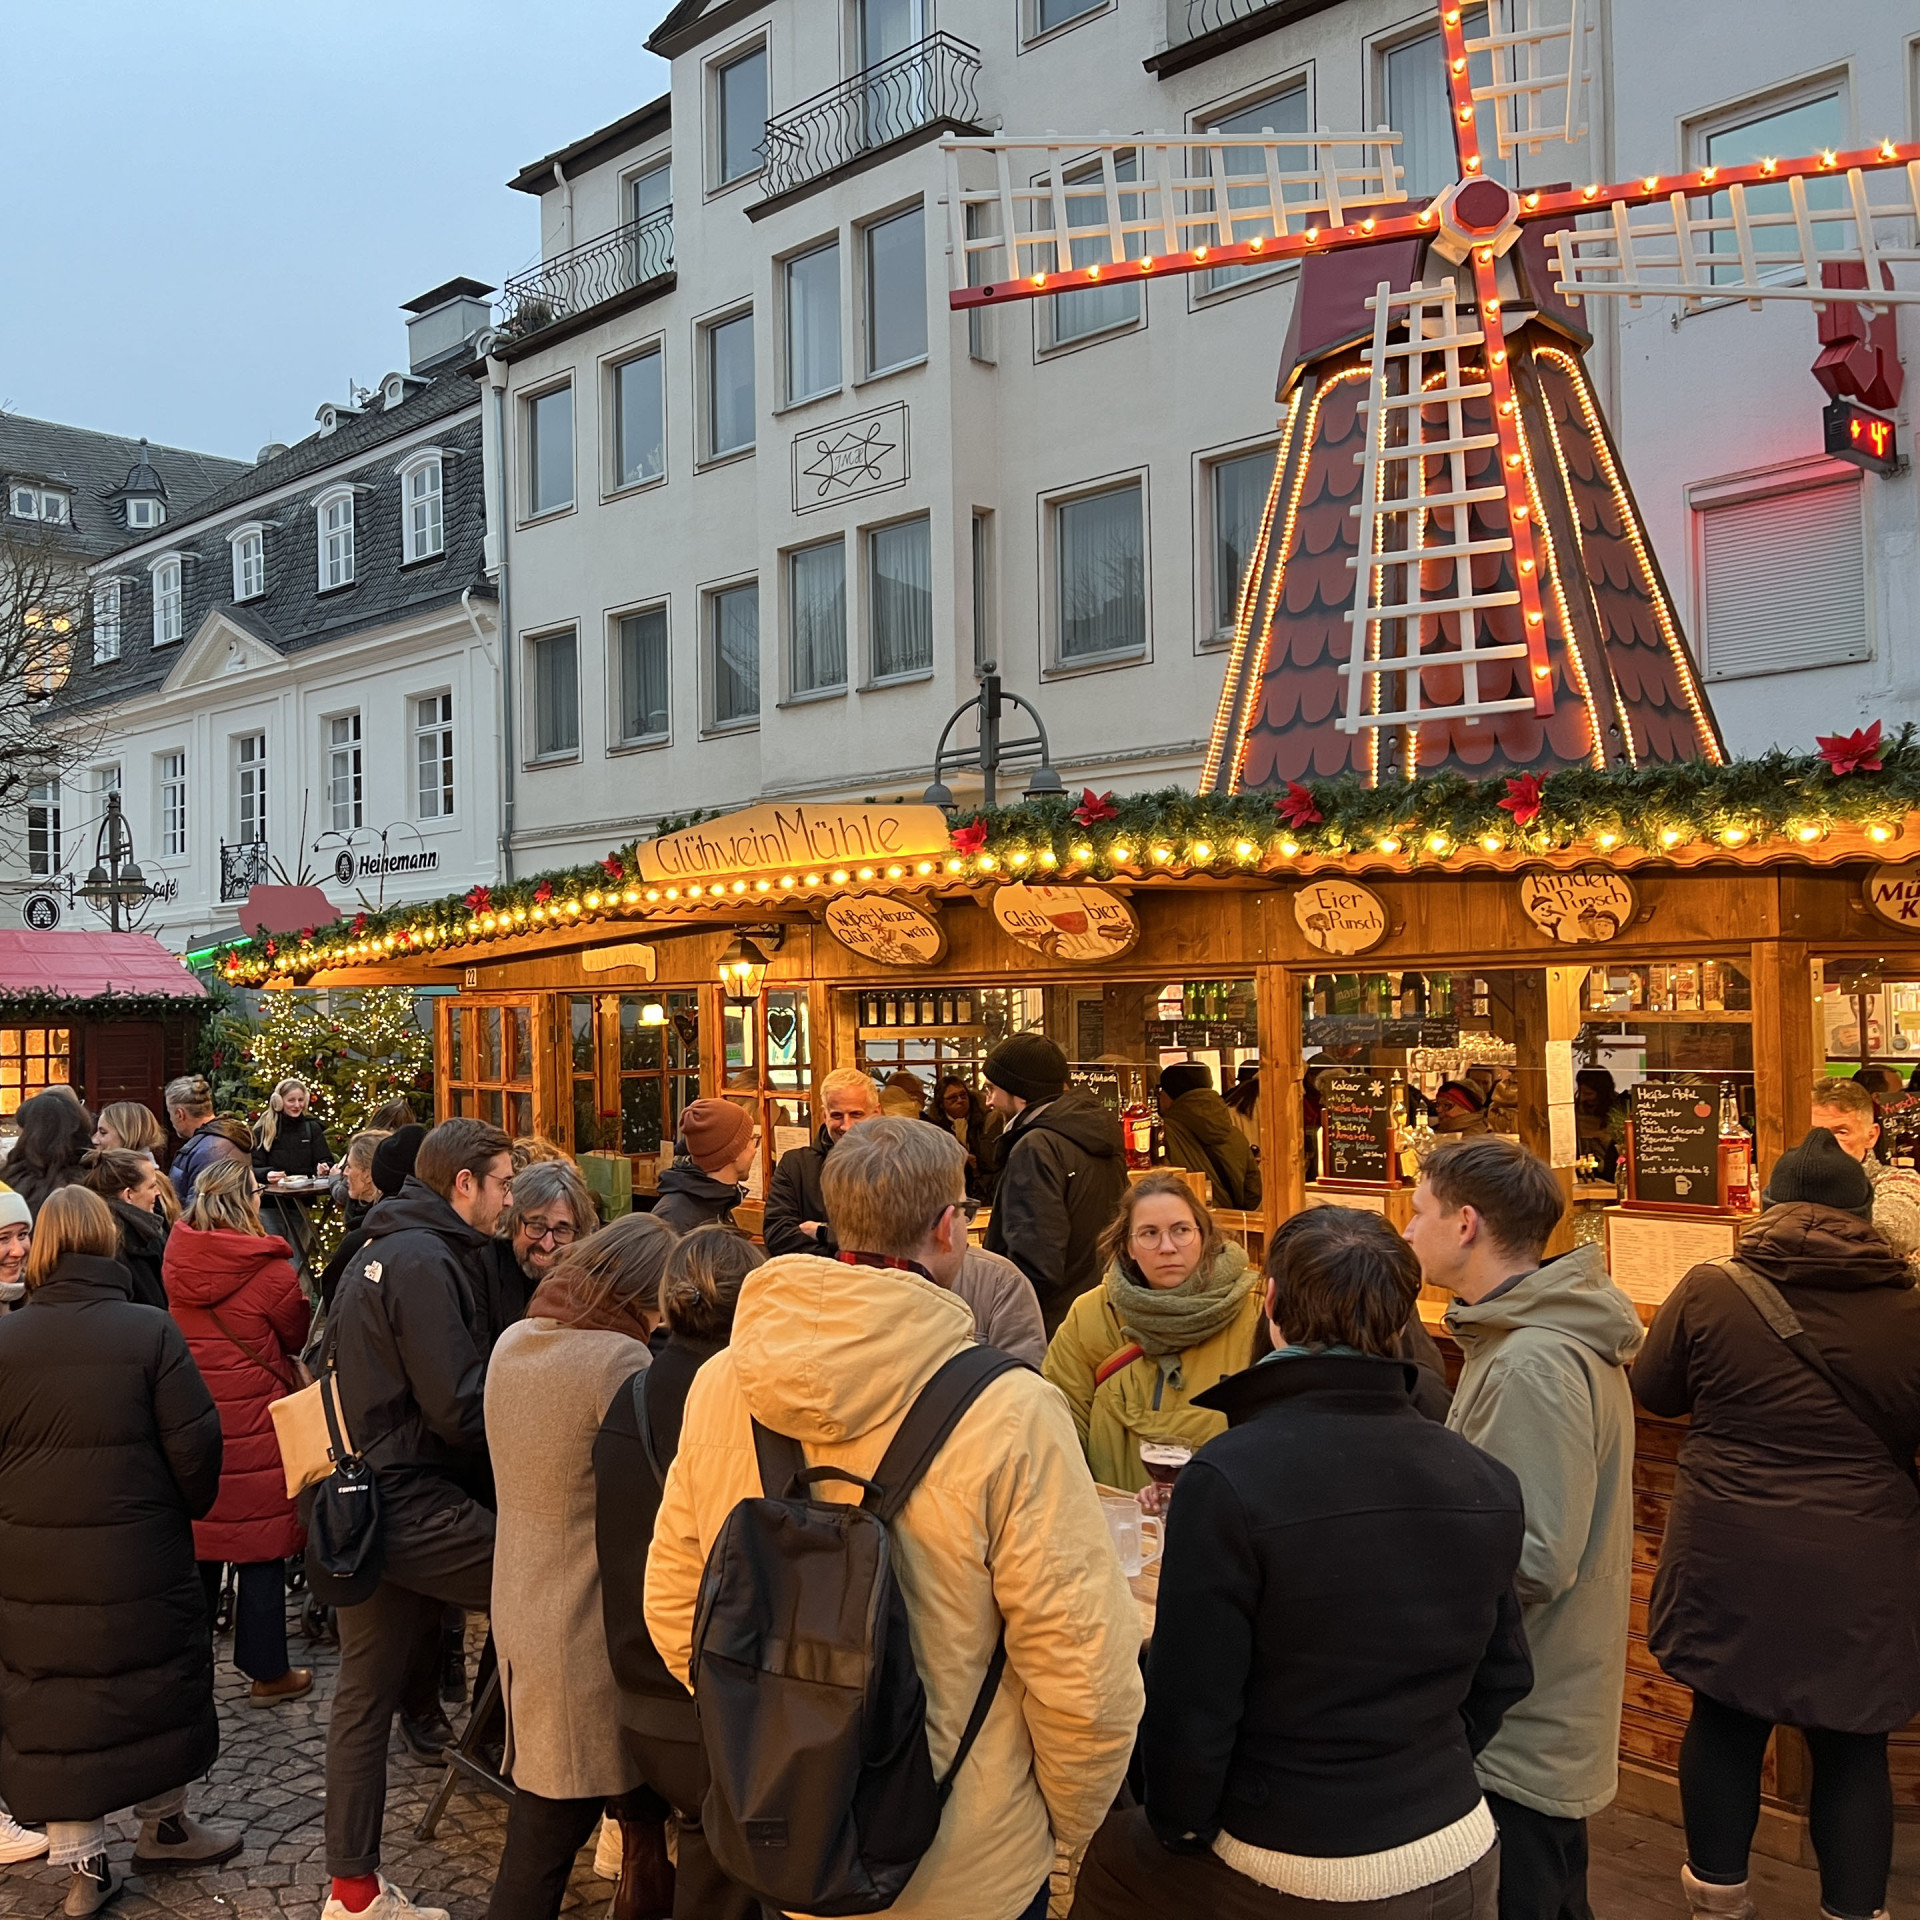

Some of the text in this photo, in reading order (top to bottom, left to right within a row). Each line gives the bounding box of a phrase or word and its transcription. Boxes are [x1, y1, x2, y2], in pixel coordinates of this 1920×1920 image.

[358, 851, 437, 876] Heinemann
[152, 878, 178, 903] Café
[1530, 868, 1616, 893] Kinder
[1315, 888, 1364, 909] Eier
[1556, 885, 1628, 911] Punsch
[869, 907, 917, 922] Winzer
[1003, 902, 1120, 928] Glüh bier
[1327, 910, 1382, 929] Punsch
[838, 925, 935, 944] Glüh wein
[466, 969, 476, 985] 22
[1331, 1080, 1361, 1091] Kakao
[1640, 1118, 1658, 1126] Gin
